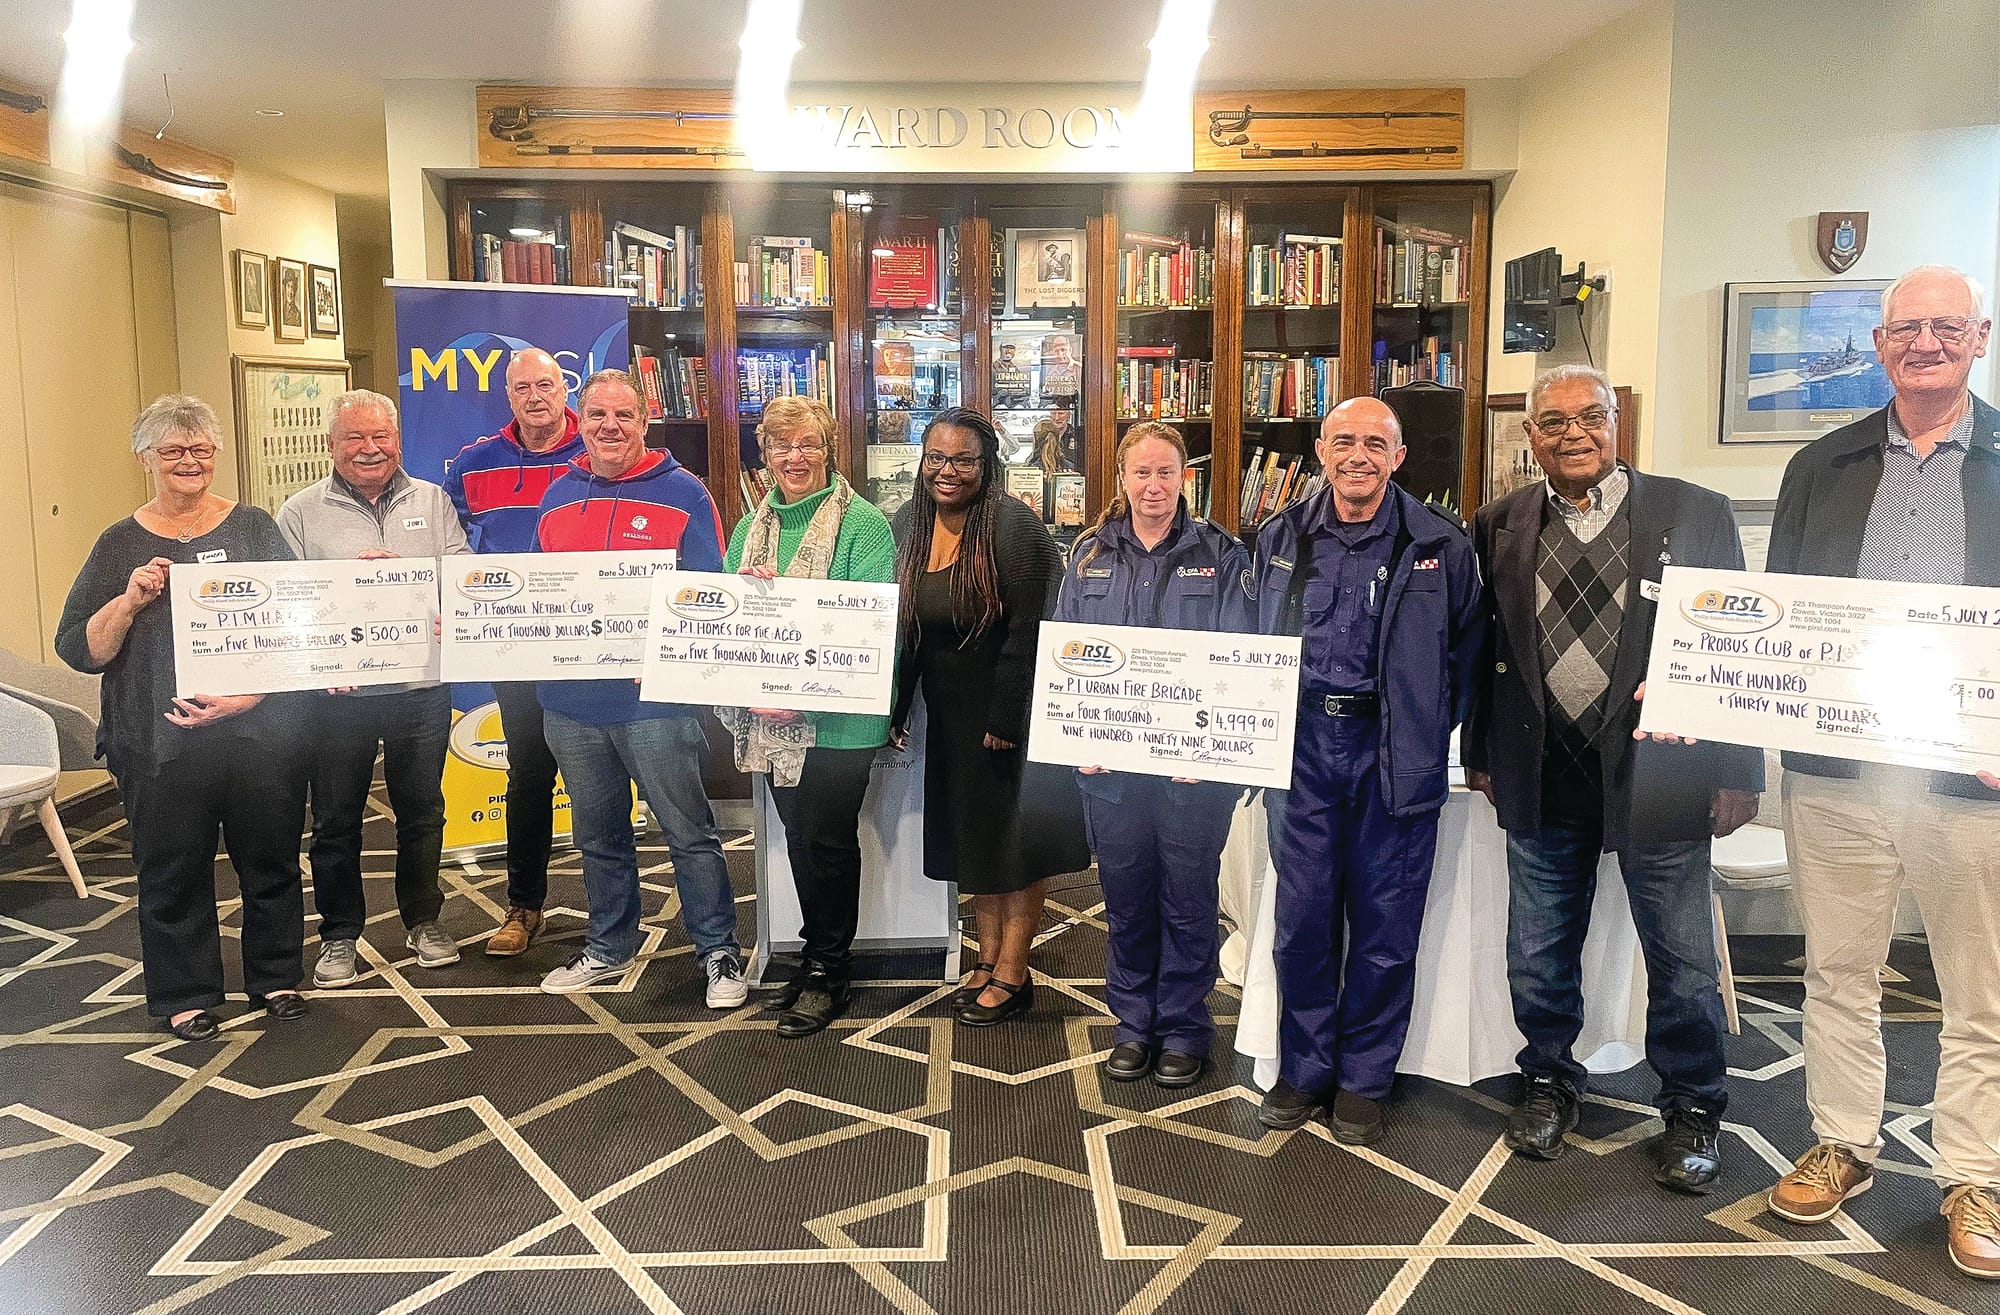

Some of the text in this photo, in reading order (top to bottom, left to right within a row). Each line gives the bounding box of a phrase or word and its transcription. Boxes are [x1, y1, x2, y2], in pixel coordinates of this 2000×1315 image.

[871, 447, 917, 455] VIETNAM
[376, 569, 384, 583] 5
[385, 571, 408, 583] JULY
[411, 569, 434, 582] 2023
[618, 562, 625, 576] 5
[626, 564, 647, 577] JULY
[483, 572, 512, 585] RSL
[223, 581, 256, 594] RSL
[695, 591, 725, 605] RSL
[817, 599, 837, 607] Date
[837, 593, 844, 607] 5
[845, 596, 867, 608] JULY
[1721, 595, 1764, 613] RSL
[455, 609, 469, 618] Pay
[491, 601, 527, 615] FOOTBALL
[531, 600, 567, 615] NETBALL
[570, 600, 594, 615] CLUB
[1792, 600, 1806, 608] 225
[1807, 601, 1845, 612] Thompson
[1819, 610, 1847, 619] Victoria
[1824, 618, 1842, 626] 1004
[1907, 609, 1939, 620] Date
[1942, 605, 1951, 623] 5
[1954, 608, 1988, 625] JULY
[190, 621, 207, 629] Pay
[473, 633, 481, 641] of
[482, 622, 505, 639] FIVE
[507, 622, 551, 638] THOUSAND
[555, 624, 590, 638] DOLLARS
[590, 619, 603, 637] $
[662, 627, 677, 635] Pay
[697, 621, 732, 636] HOMES
[735, 624, 752, 637] FOR
[754, 625, 770, 639] THE
[774, 627, 802, 642] AGED
[1789, 622, 1852, 634] www.pirsl.com.au
[225, 634, 248, 651] FIVE
[350, 626, 365, 644] $
[192, 639, 207, 647] the
[660, 644, 674, 652] the
[1673, 638, 1694, 650] Pay
[1700, 632, 1749, 654] PROBUS
[1754, 636, 1793, 658] CLUB
[552, 655, 582, 663] Signed:
[689, 642, 709, 660] FIVE
[712, 643, 758, 662] THOUSAND
[760, 647, 800, 667] DOLLARS
[804, 648, 817, 667] $
[1082, 644, 1112, 659] RSL
[1208, 650, 1298, 667] Date 5 JULY 2023
[310, 663, 344, 672] Signed:
[1669, 661, 1688, 672] the
[1668, 664, 1808, 693] sum of NINE HUNDRED
[761, 682, 793, 692] Signed:
[1048, 682, 1064, 691] Pay
[1085, 679, 1120, 696] URBAN
[1124, 679, 1148, 697] FIRE
[1151, 681, 1203, 703] BRIGADE
[1047, 702, 1061, 710] the
[1727, 691, 1770, 713] THIRTY
[1775, 700, 1810, 719] NINE
[1047, 701, 1153, 725] sum of FOUR THOUSAND
[1194, 709, 1209, 730] $
[1815, 720, 1864, 734] Signed:
[1061, 724, 1254, 756] NINE HUNDRED NINETY NINE DOLLARS
[1149, 746, 1183, 757] Signed:
